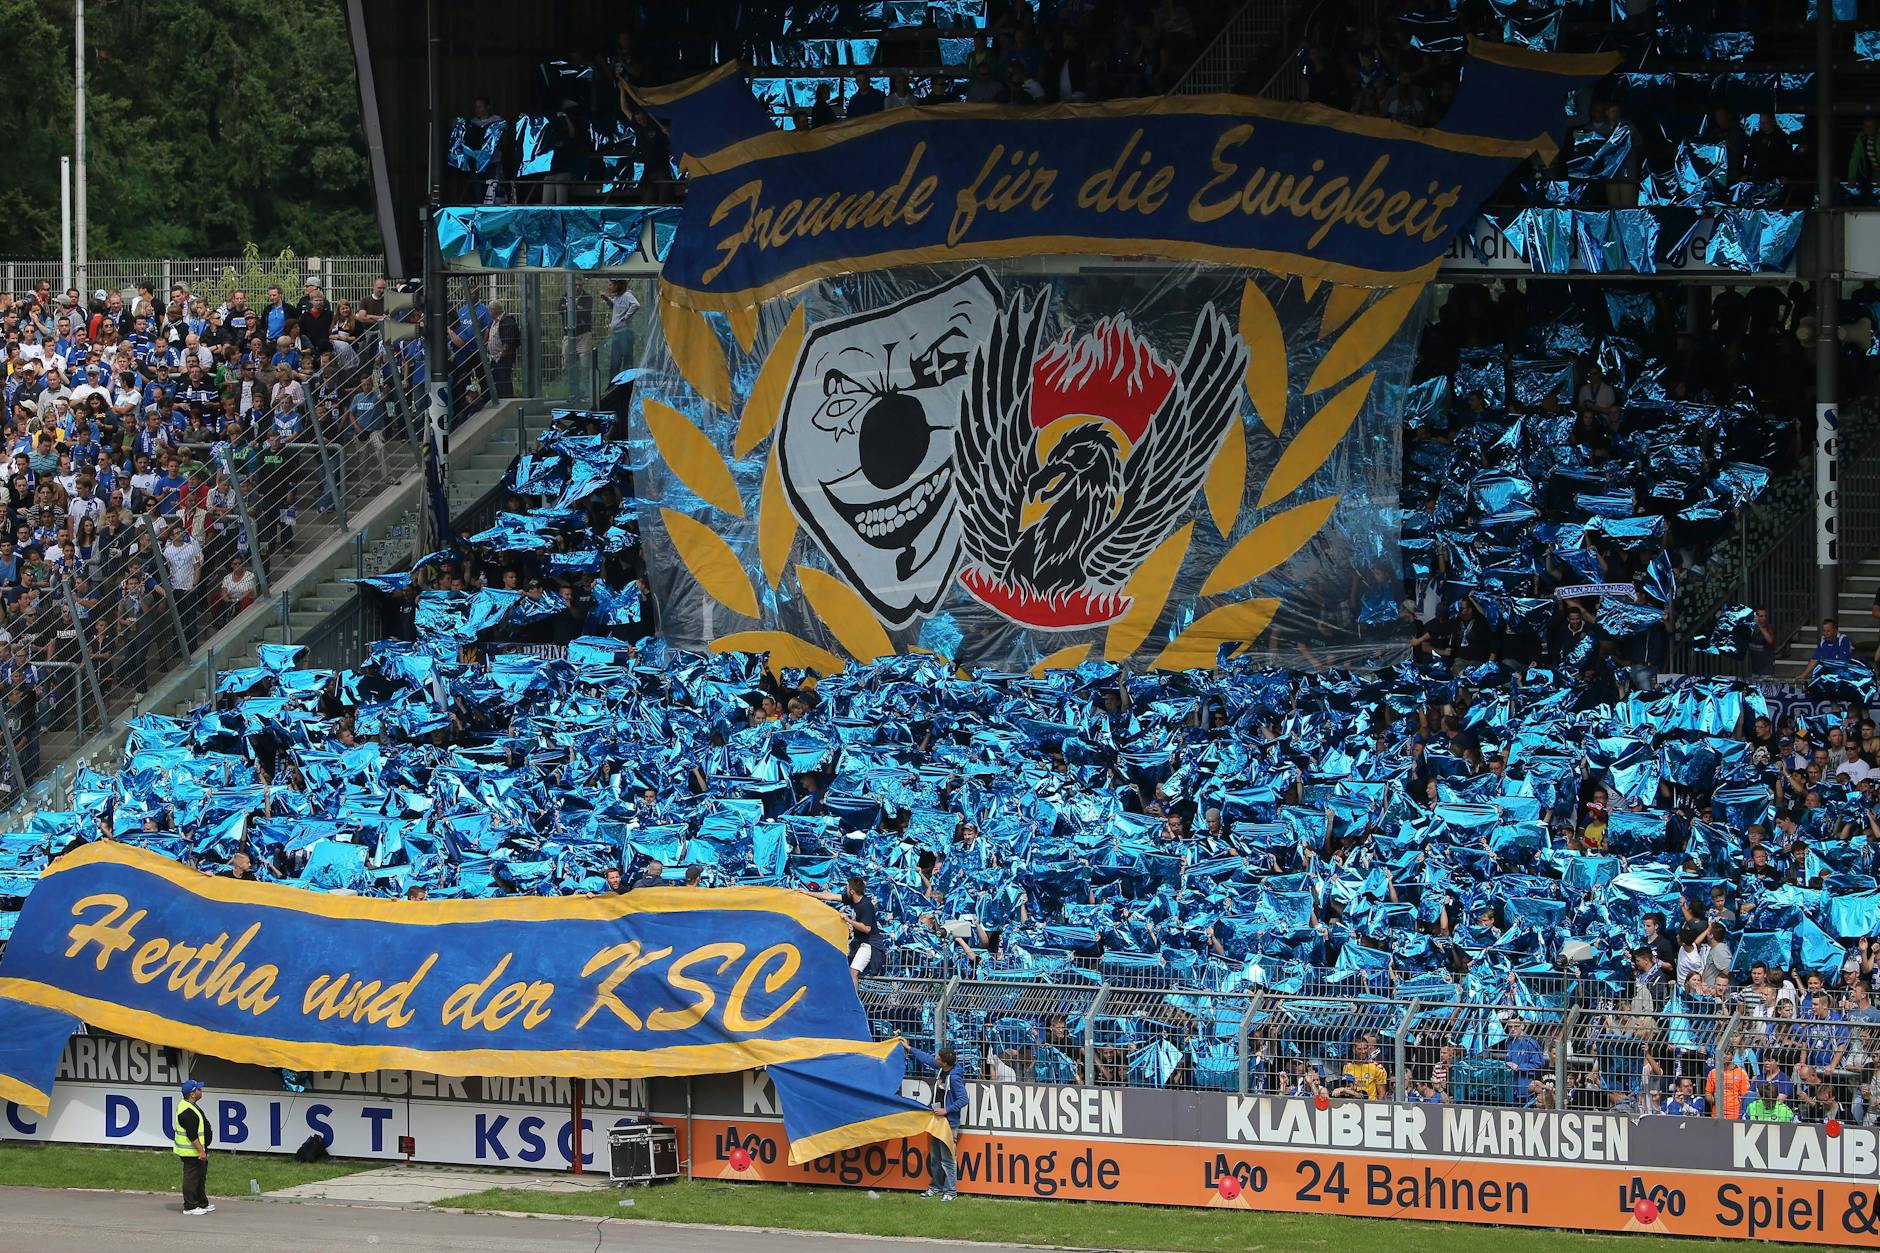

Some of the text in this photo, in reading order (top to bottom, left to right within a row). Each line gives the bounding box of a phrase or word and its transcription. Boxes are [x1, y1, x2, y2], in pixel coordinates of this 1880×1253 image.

[702, 123, 1462, 285] Freunde für die Ewigkeit
[64, 893, 808, 1033] Hertha und der KSC
[475, 1113, 594, 1165] KSC
[715, 1125, 777, 1165] LAGO
[1226, 1095, 1629, 1162] KLAIBER MARKISEN
[1733, 1121, 1880, 1176] KLAIB
[803, 1137, 1121, 1196] ago-bwling.de
[1204, 1152, 1529, 1214] LAGO 24 Bahnen
[1618, 1176, 1879, 1238] LAGO Spiel &
